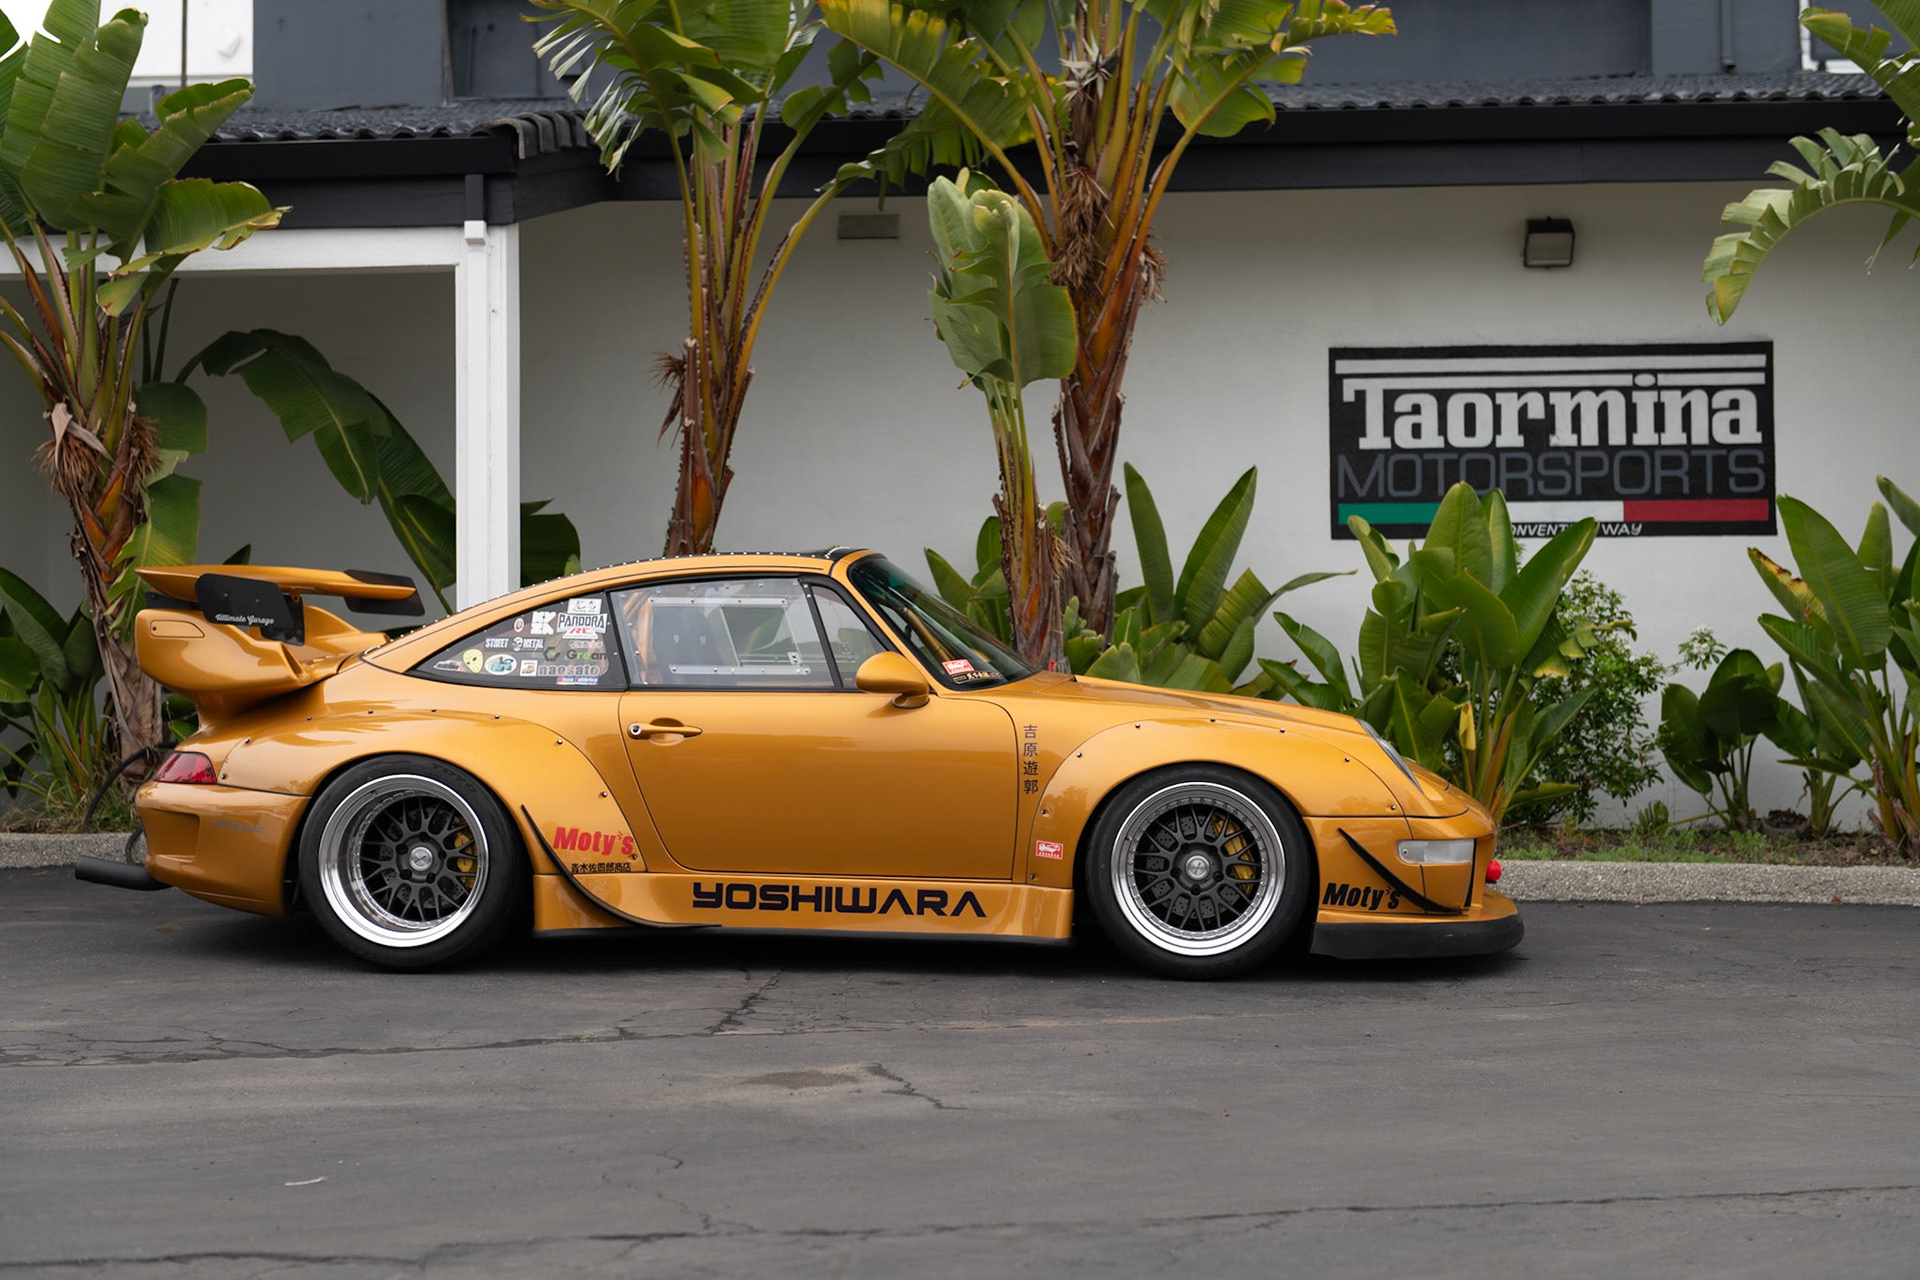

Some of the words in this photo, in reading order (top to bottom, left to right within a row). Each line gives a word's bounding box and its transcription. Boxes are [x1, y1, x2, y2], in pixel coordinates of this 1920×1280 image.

[1342, 372, 1765, 450] Taormina
[1338, 449, 1766, 498] MOTORSPORTS
[1511, 523, 1573, 536] NVENT
[1602, 522, 1643, 536] WAY
[247, 615, 275, 626] Garage
[558, 614, 605, 629] PANDORA
[566, 649, 606, 660] Grean
[1023, 724, 1038, 794] 吉原遊郭
[553, 827, 634, 856] Moty's
[692, 881, 987, 918] YOSHIWARA
[1322, 882, 1400, 911] Moty's
